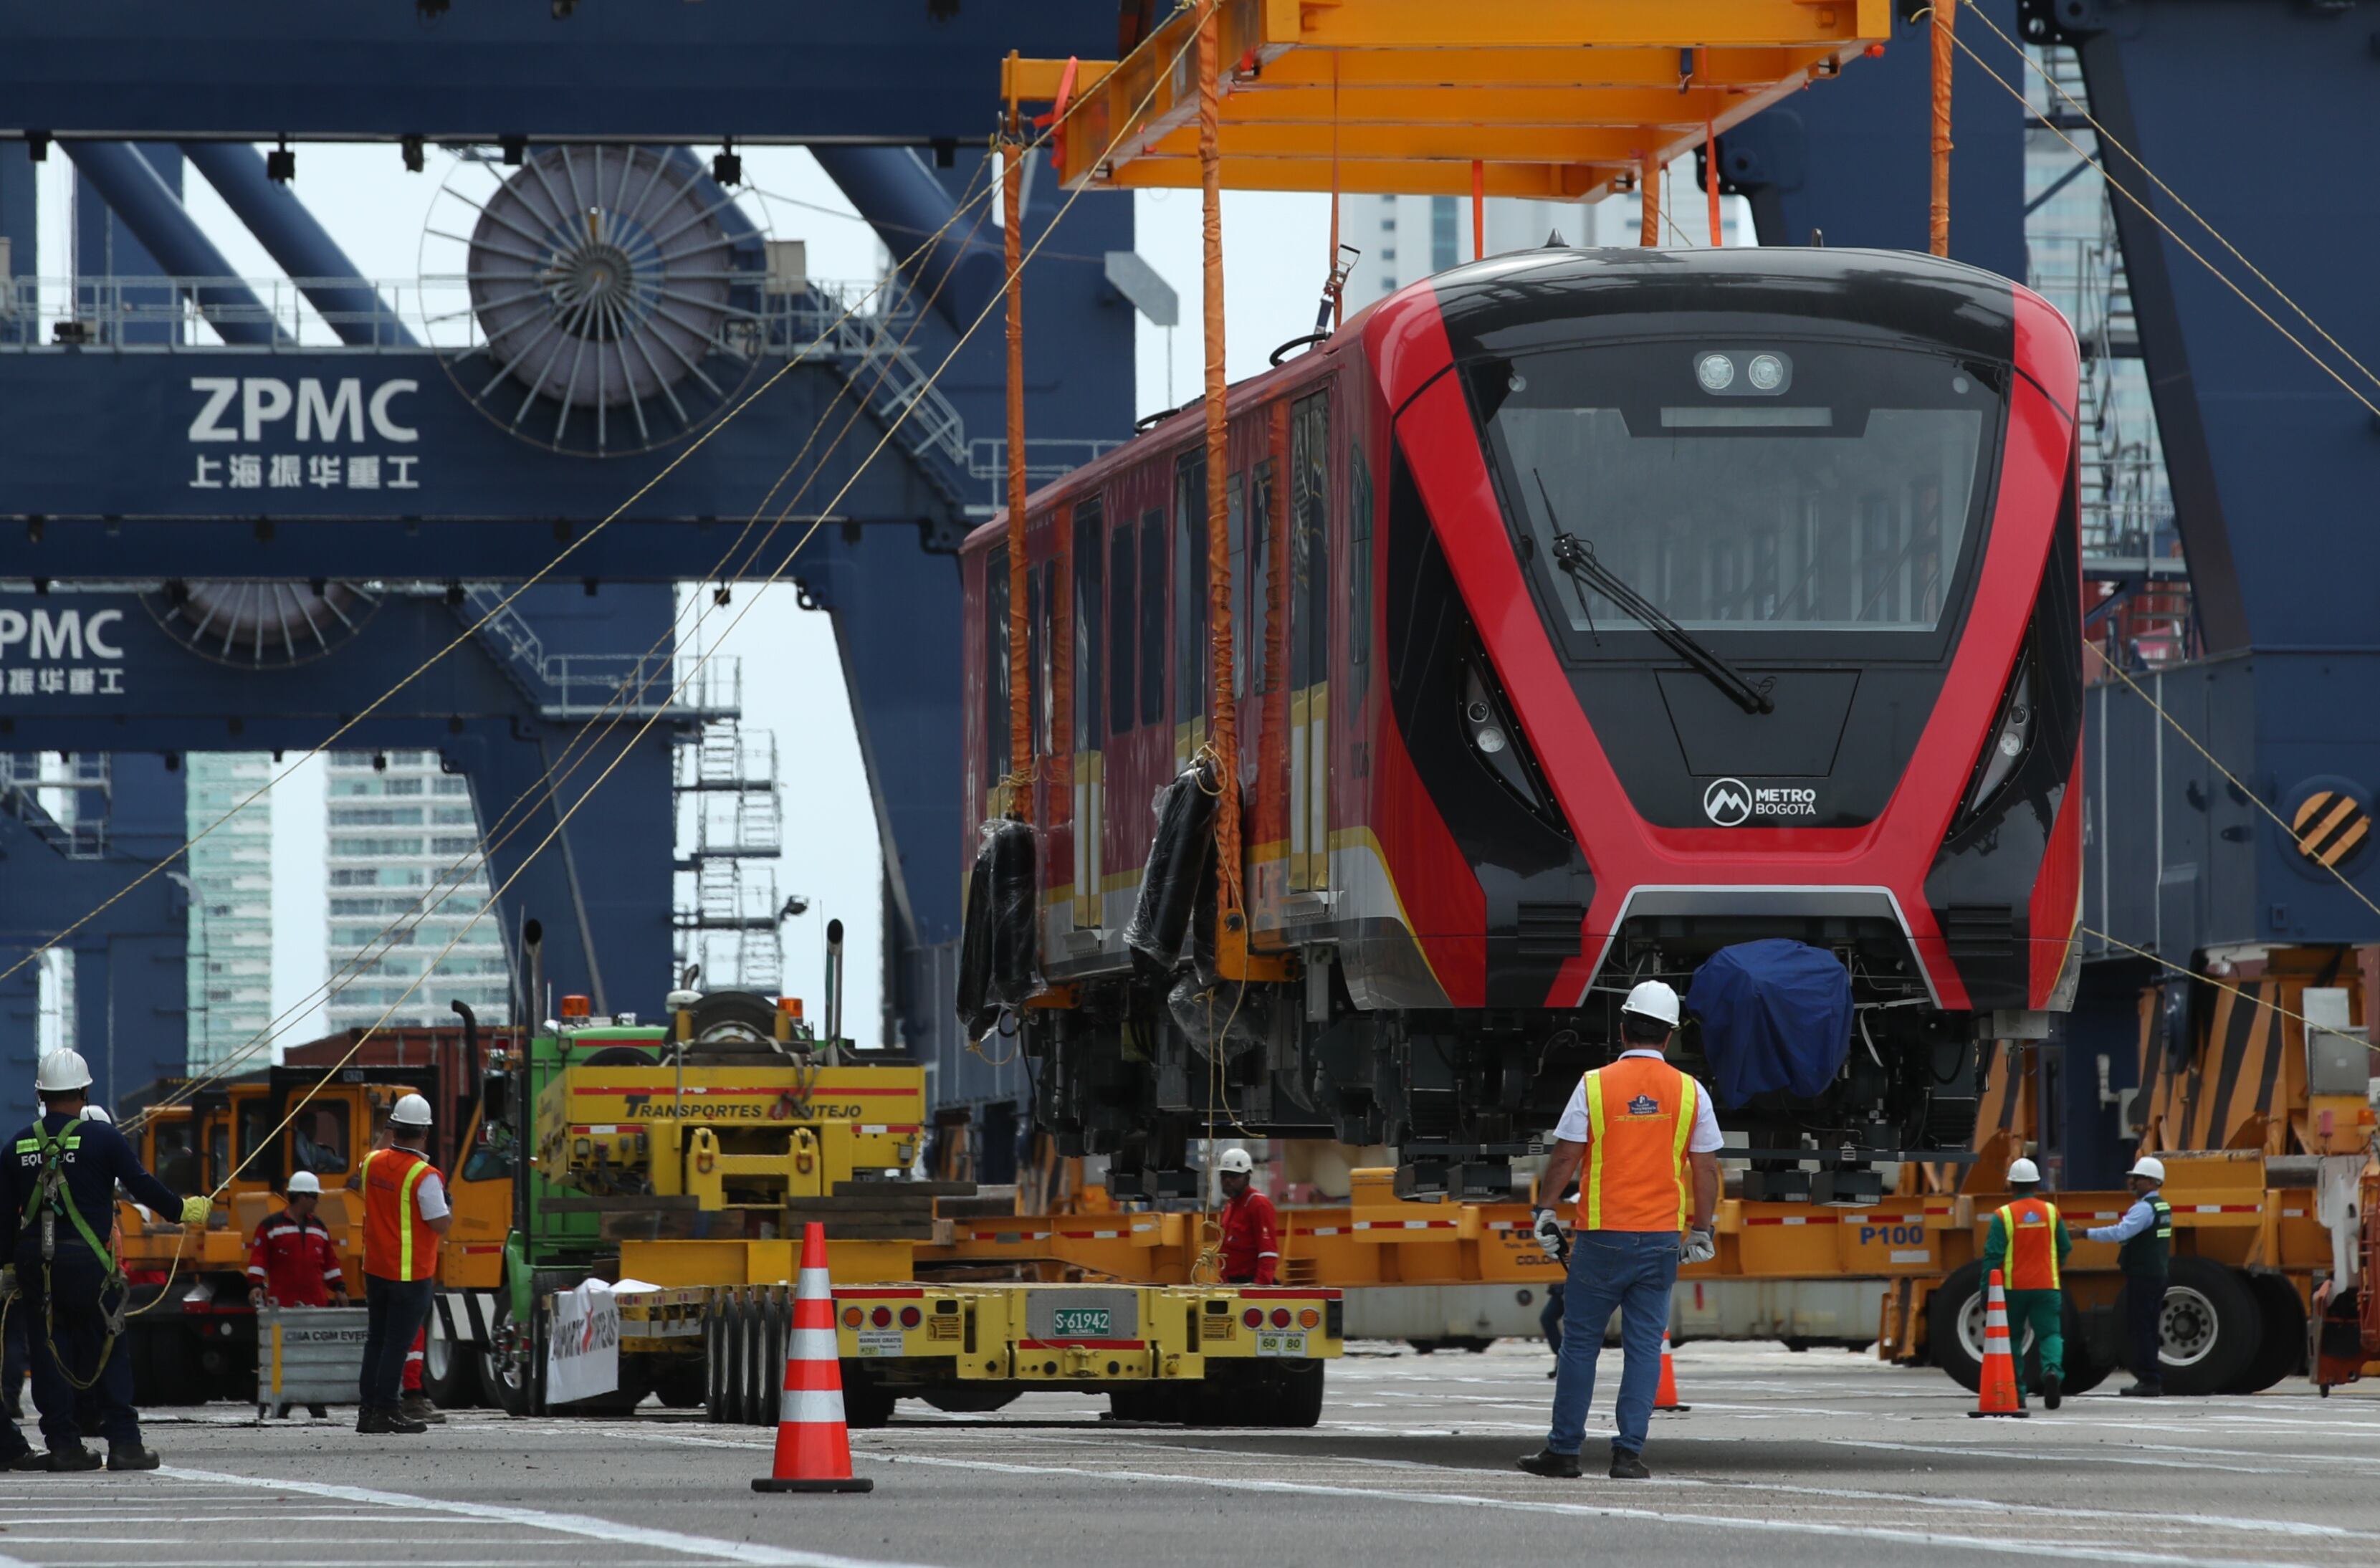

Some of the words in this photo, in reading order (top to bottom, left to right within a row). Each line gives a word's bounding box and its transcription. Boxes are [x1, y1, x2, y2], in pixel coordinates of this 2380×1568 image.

[188, 377, 419, 442] ZPMC
[189, 454, 419, 489] 上海振华重工
[0, 668, 125, 695] 振华重工
[1756, 789, 1816, 802] METRO
[1756, 801, 1817, 815] BOGOTÁ
[1860, 1226, 1923, 1245] P100
[1263, 1338, 1276, 1347] 60
[1286, 1339, 1301, 1348] 80
